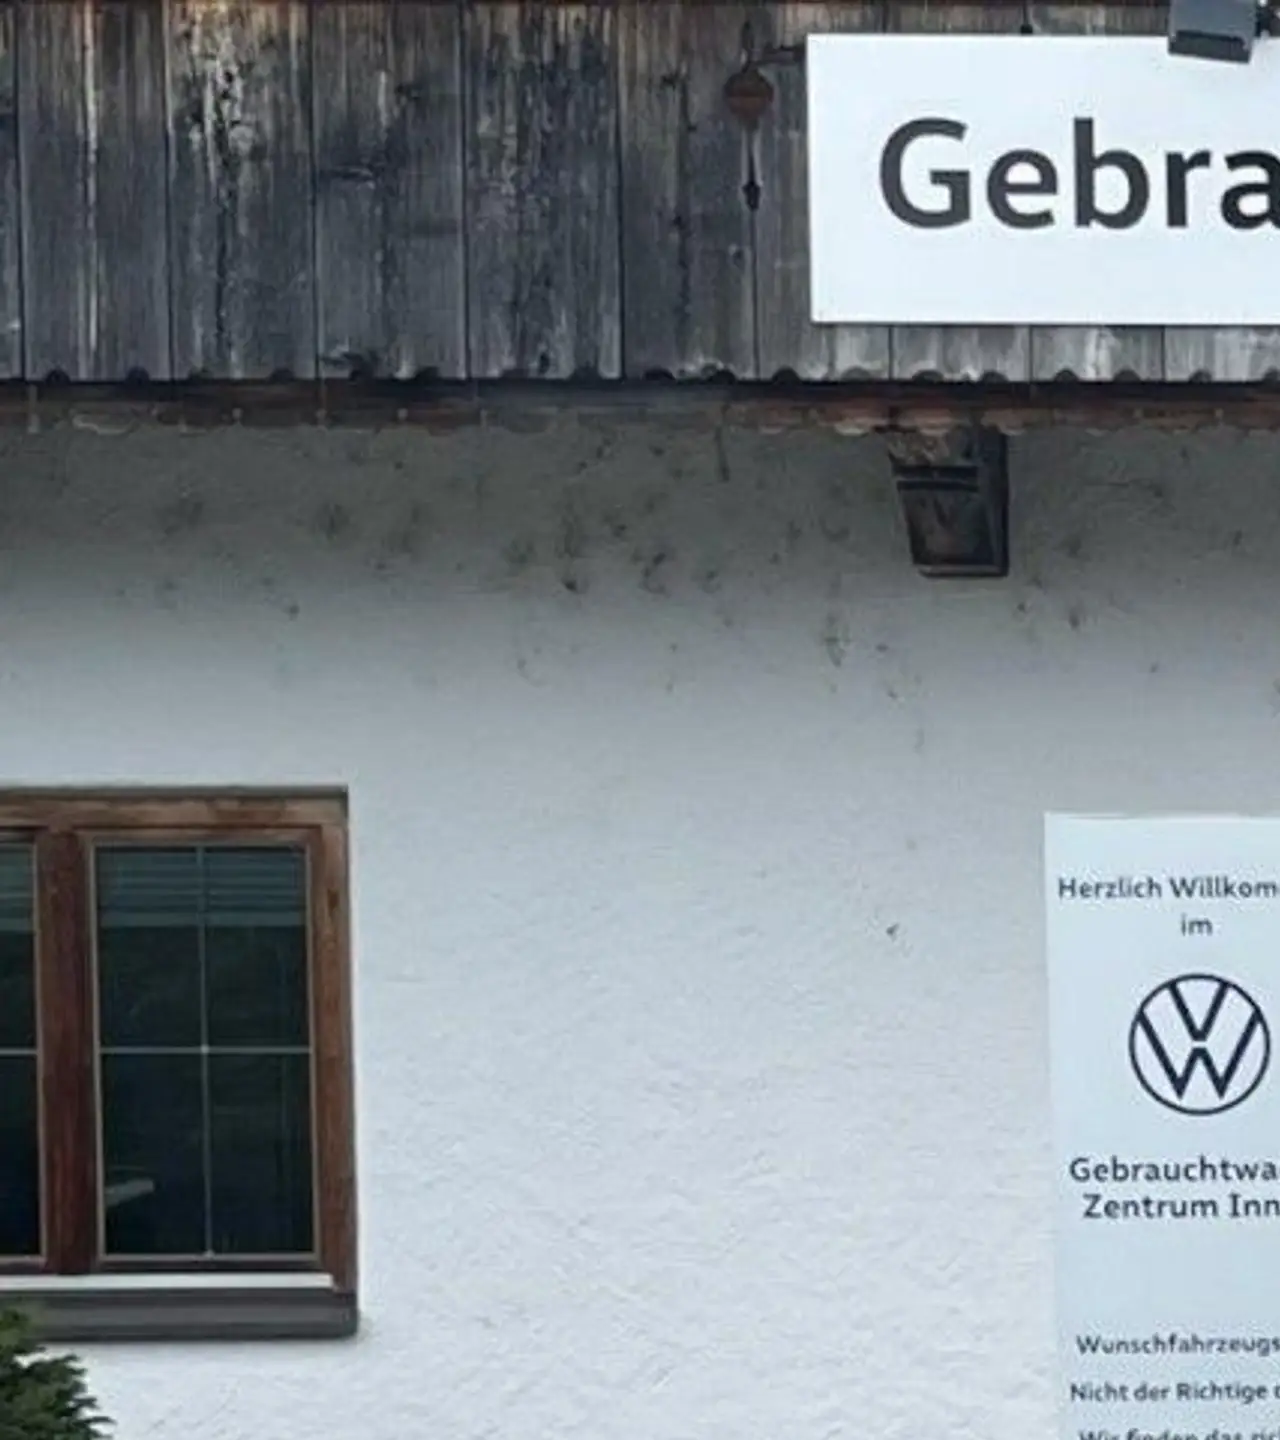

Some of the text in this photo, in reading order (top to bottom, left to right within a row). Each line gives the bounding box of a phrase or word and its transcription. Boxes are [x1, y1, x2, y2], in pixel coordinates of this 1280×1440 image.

[1058, 876, 1162, 899] Herzlich
[1180, 914, 1213, 936] im
[1083, 1193, 1219, 1219] Zentrum
[1070, 1382, 1129, 1402] Nicht
[1133, 1383, 1170, 1402] der
[1176, 1381, 1268, 1405] Richtige
